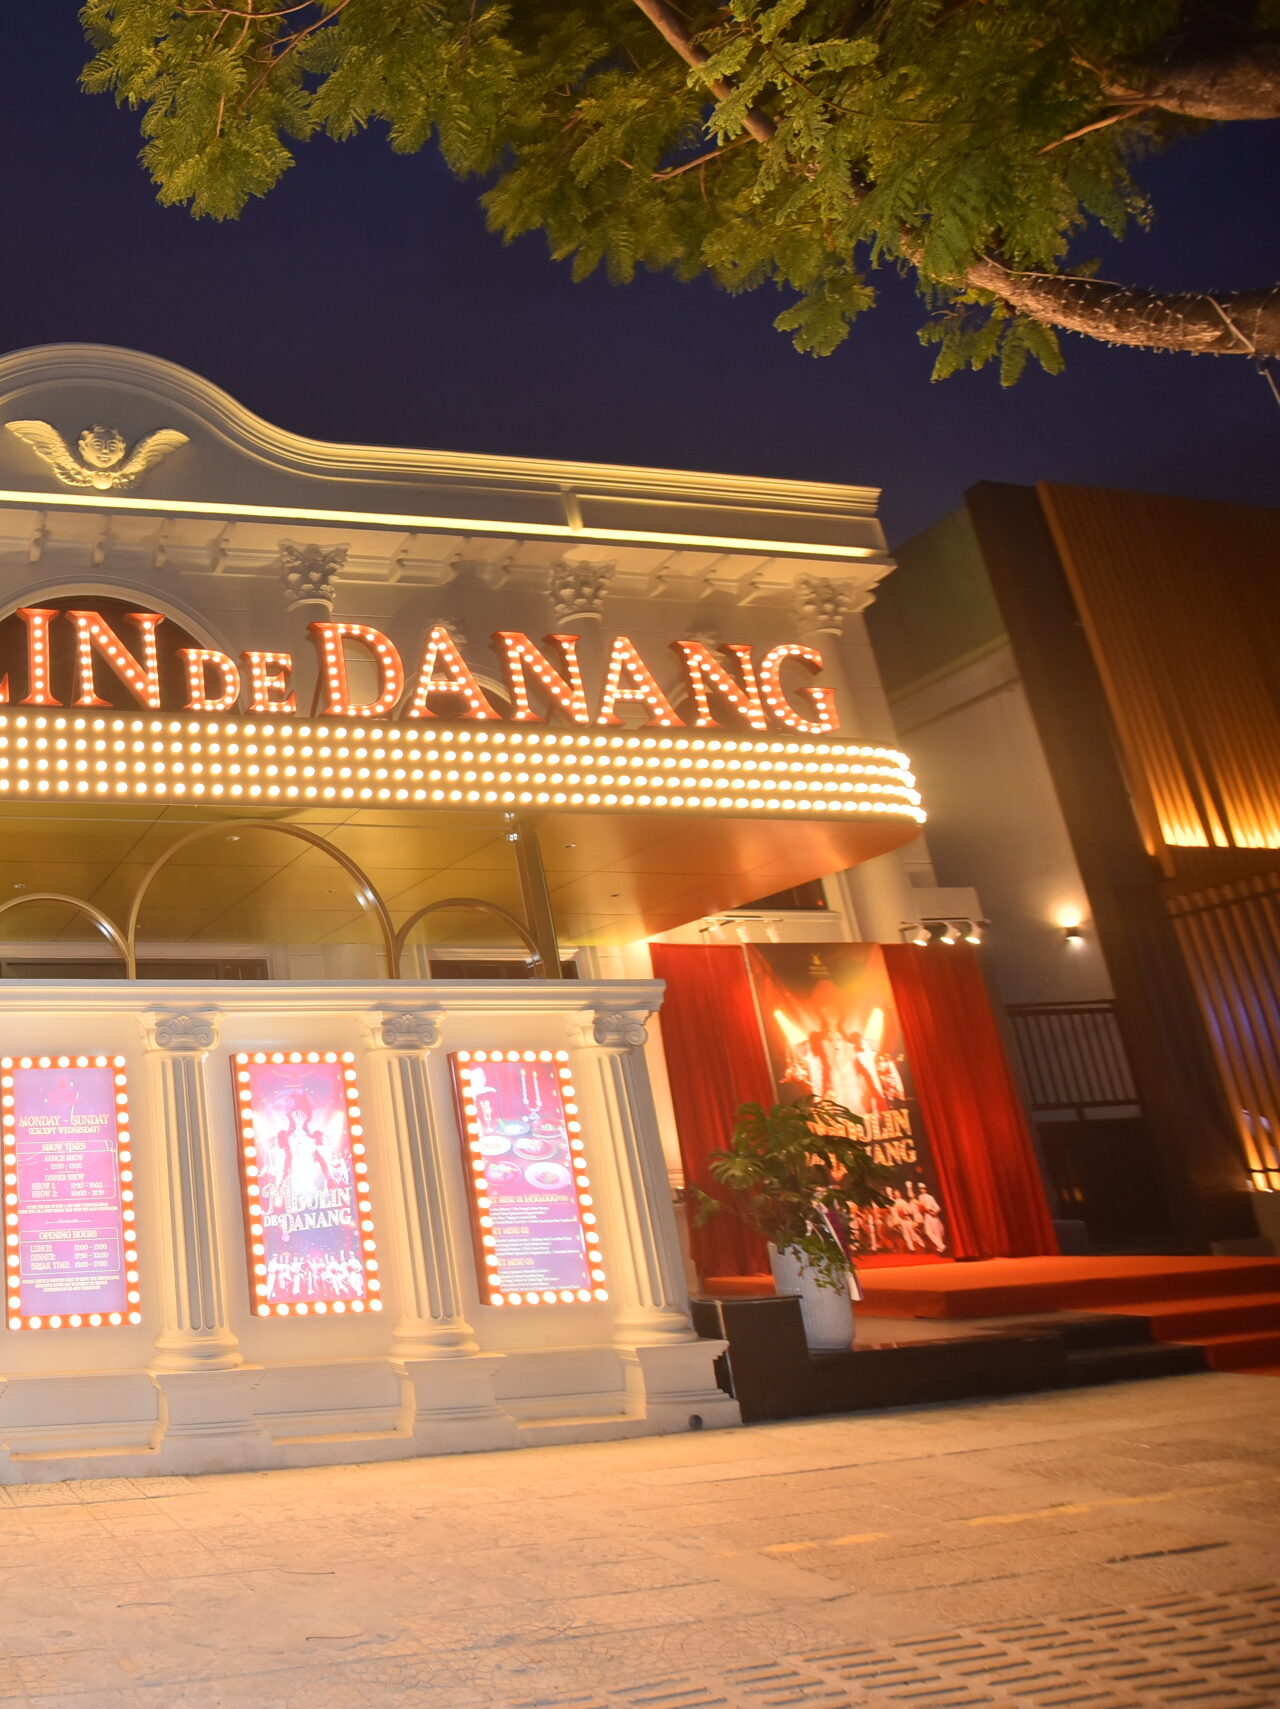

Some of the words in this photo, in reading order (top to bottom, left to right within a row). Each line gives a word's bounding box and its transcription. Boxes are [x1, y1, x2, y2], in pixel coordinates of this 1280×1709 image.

[177, 647, 297, 713] DE
[307, 621, 841, 734] DANANG
[19, 1115, 60, 1127] MONDAY
[71, 1114, 109, 1125] SUNDAY
[42, 1143, 63, 1152] SHOW
[64, 1142, 87, 1151] TIMES
[261, 1179, 353, 1215] MOULIN
[264, 1214, 278, 1227] DE
[277, 1208, 353, 1235] DANANG
[39, 1230, 71, 1240] OPENING
[72, 1229, 98, 1239] HOURS
